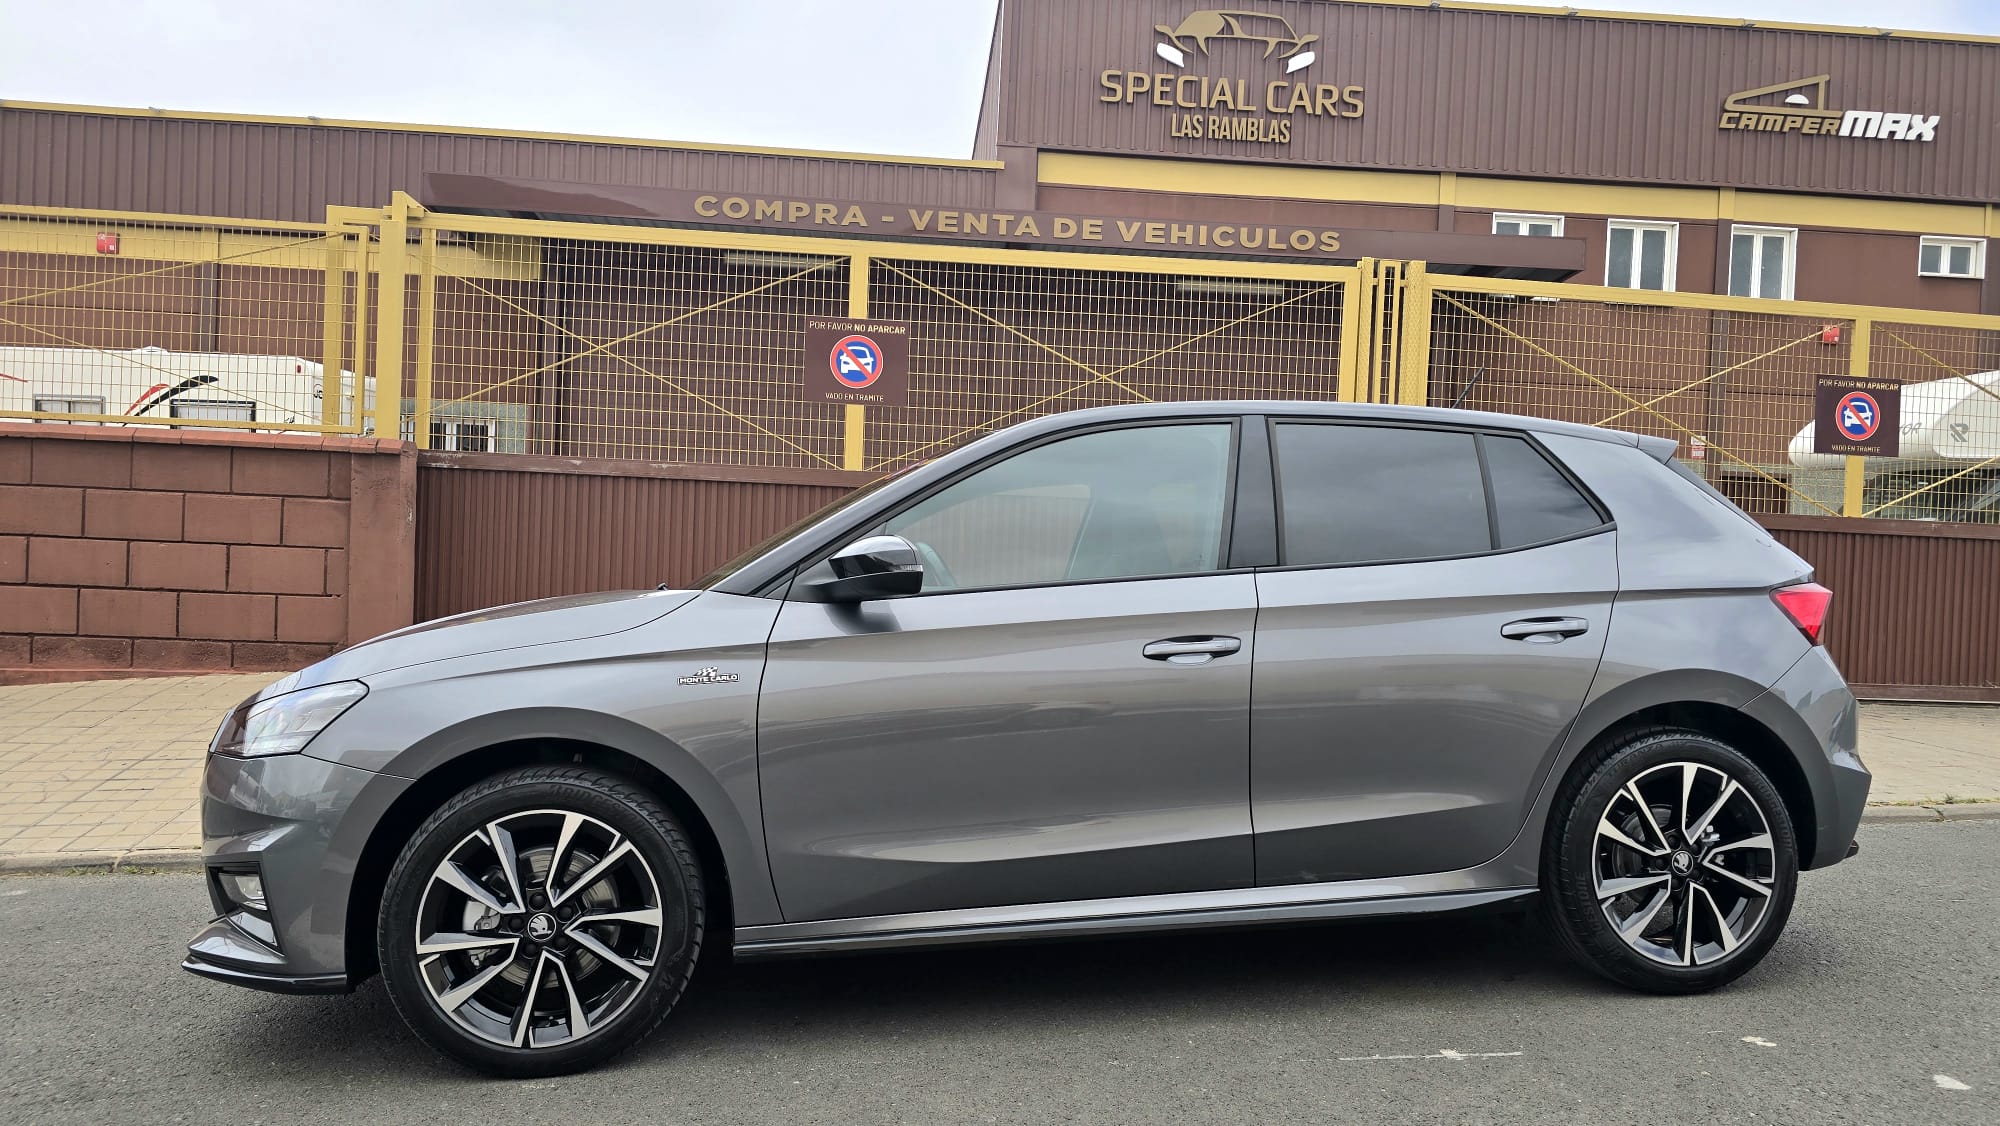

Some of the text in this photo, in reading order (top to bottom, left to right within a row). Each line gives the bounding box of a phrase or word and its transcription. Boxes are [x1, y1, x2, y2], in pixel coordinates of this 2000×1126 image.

[1100, 69, 1365, 118] SPECIAL CARS
[1171, 113, 1291, 144] LAS RAMBLAS
[694, 195, 869, 227] COMPRA
[908, 208, 1041, 237] VENTA
[1053, 217, 1104, 241] DE
[1116, 220, 1341, 253] VEHICULOS
[809, 320, 906, 335] POR FAVOR NO APARCAR
[1819, 378, 1899, 391] POR FAVOR NO APARCAR
[825, 392, 884, 402] VADO EN TRAMITE
[1831, 444, 1847, 452] VADO
[1856, 445, 1881, 454] TRAMITE
[679, 674, 738, 684] MONTE CARLO
